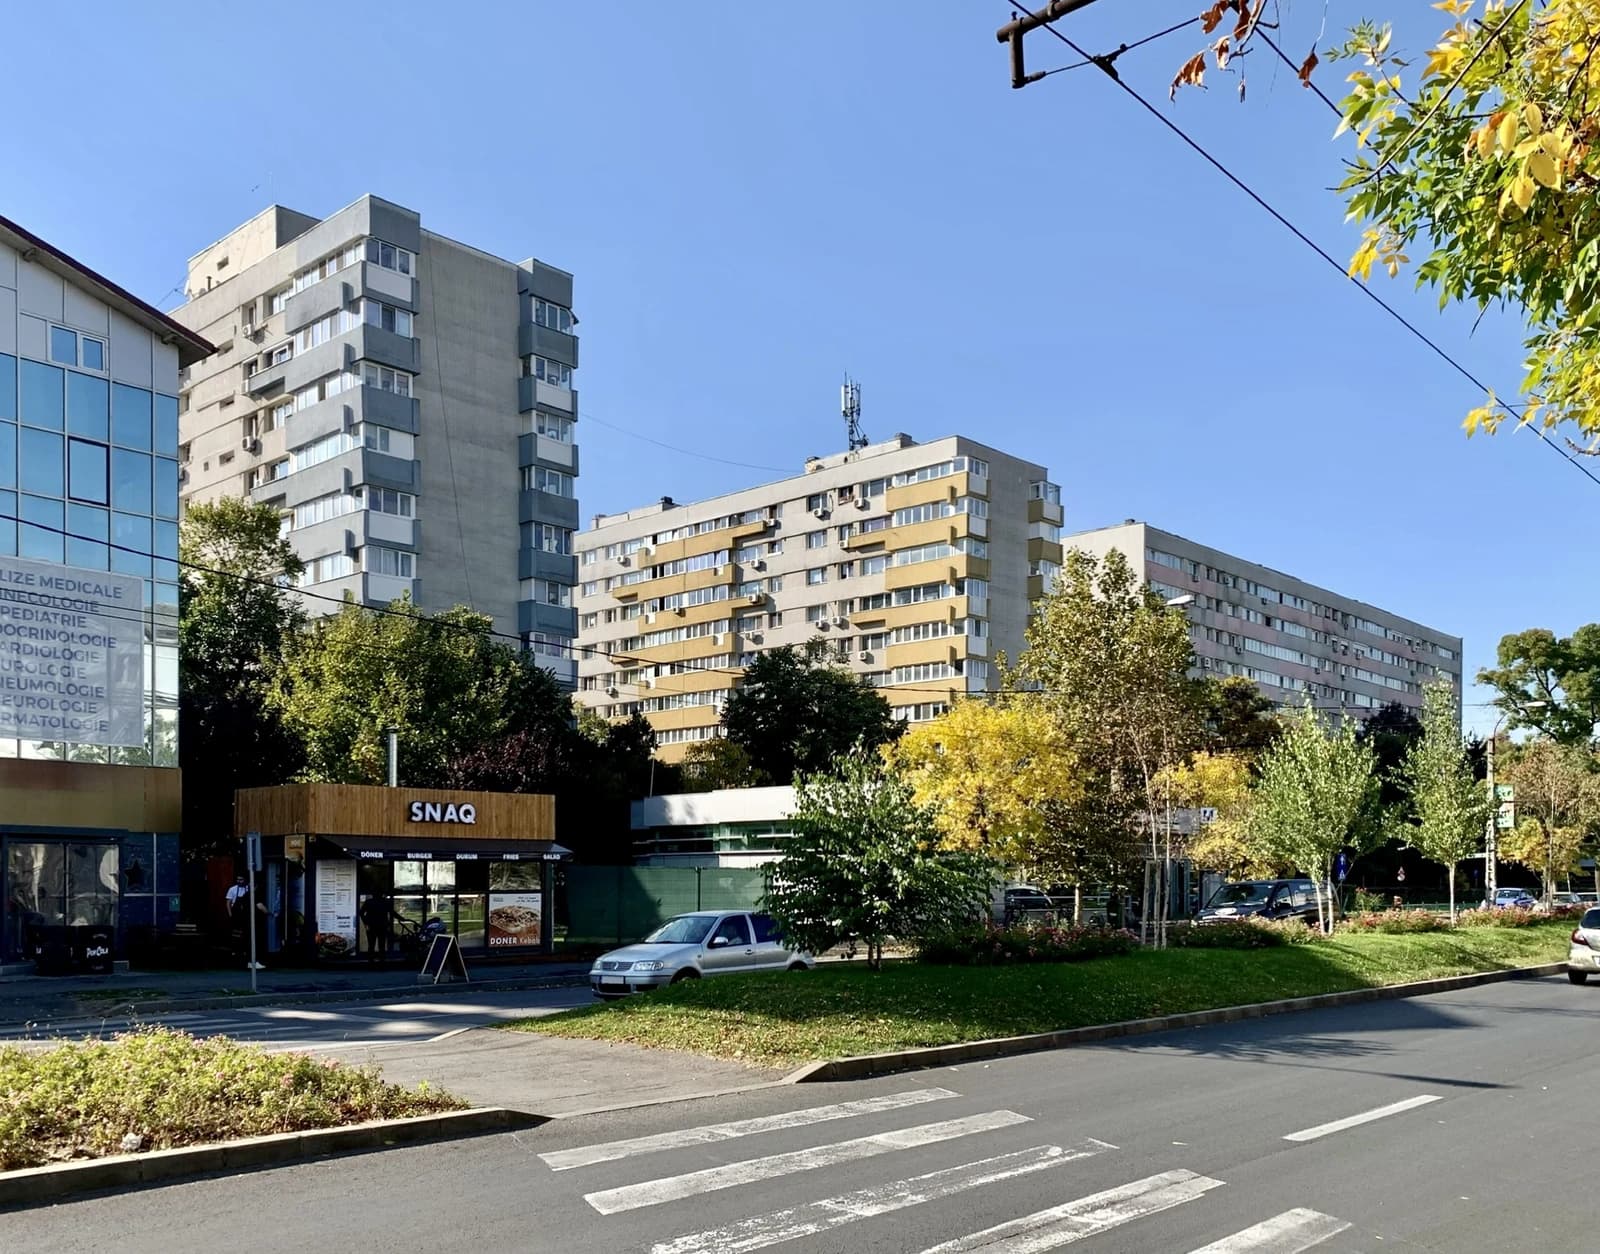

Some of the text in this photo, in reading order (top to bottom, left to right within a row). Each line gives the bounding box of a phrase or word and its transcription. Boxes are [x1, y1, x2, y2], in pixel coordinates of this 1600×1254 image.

[39, 576, 122, 599] MEDICALE
[0, 605, 87, 629] PEDIATRIE
[0, 623, 117, 649] OCRINOLOGIE
[1, 659, 87, 680] UROLOGIE
[0, 676, 105, 699] EUMOLOGIE
[411, 801, 476, 824] SNAQ
